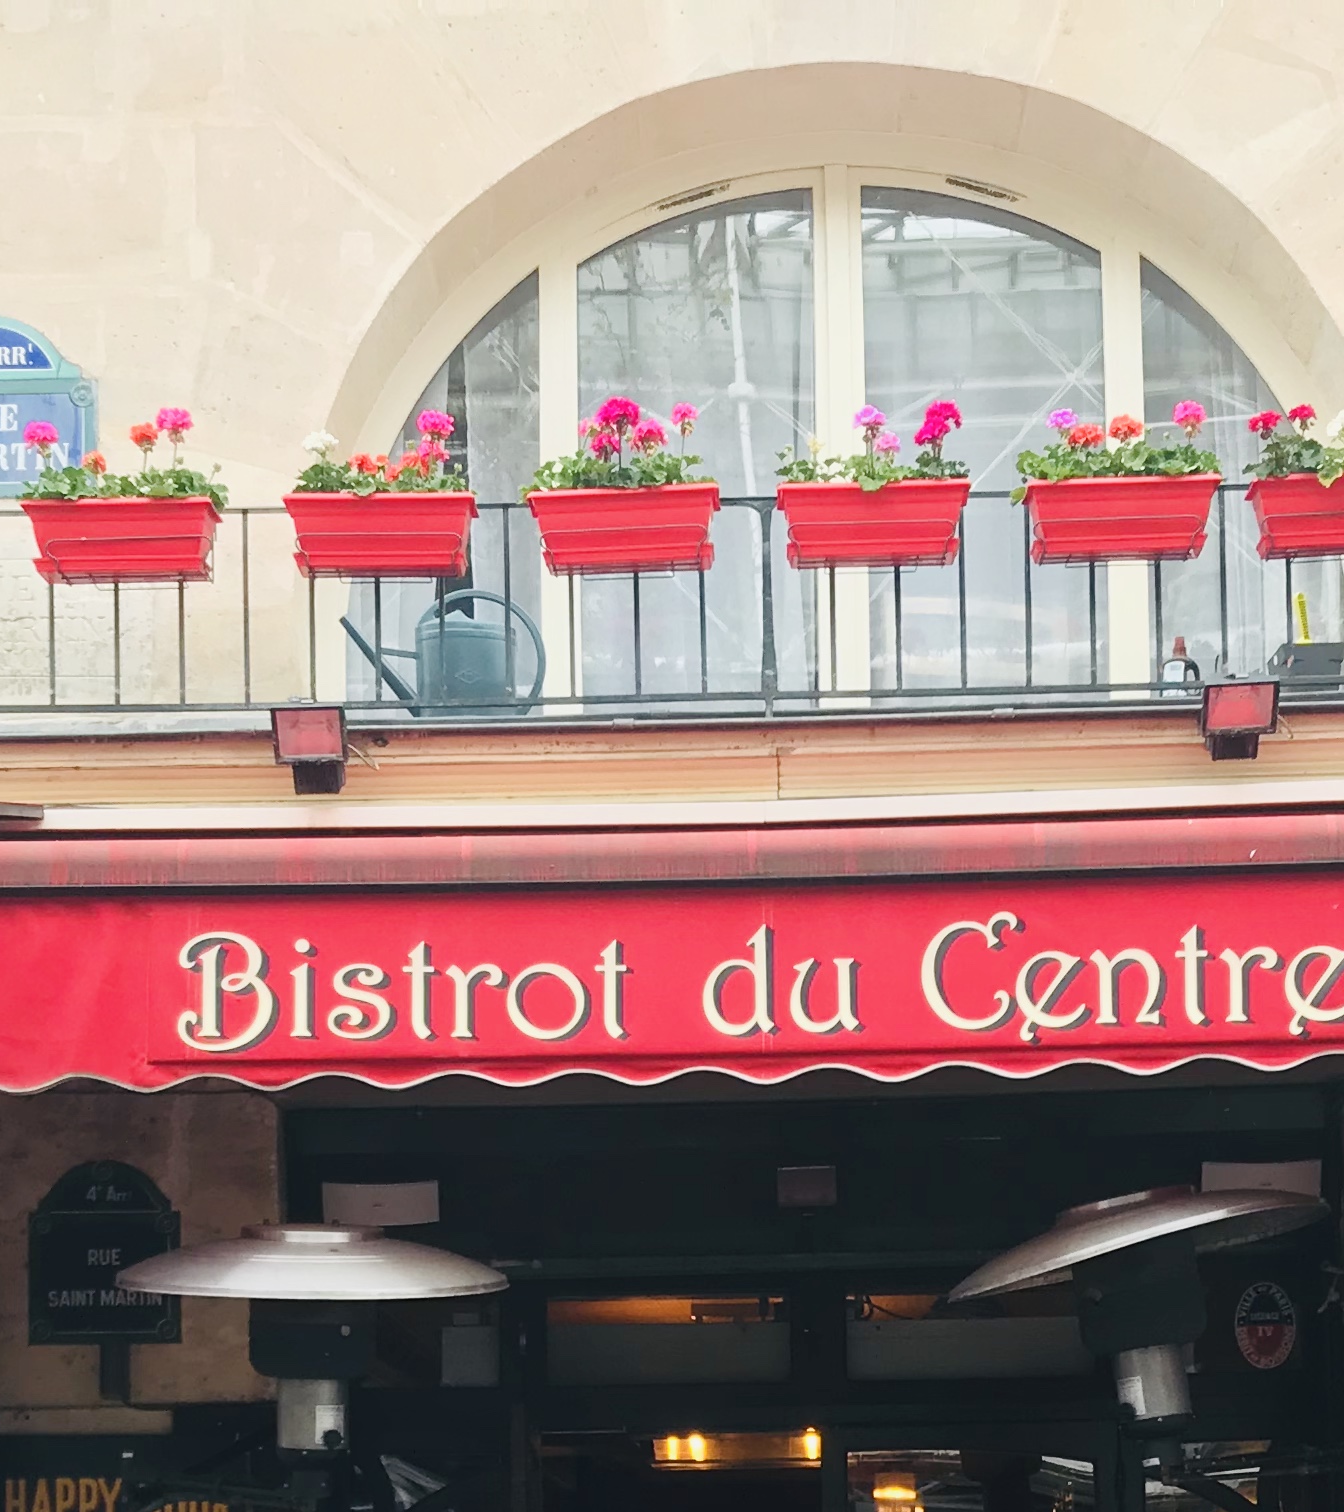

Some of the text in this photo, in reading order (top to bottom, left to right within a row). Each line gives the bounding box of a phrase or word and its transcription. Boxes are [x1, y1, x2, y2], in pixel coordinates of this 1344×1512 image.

[176, 930, 632, 1054] Bistrot
[701, 923, 864, 1037] du
[87, 1248, 121, 1266] RUE
[48, 1289, 162, 1308] SAINT MARTIN
